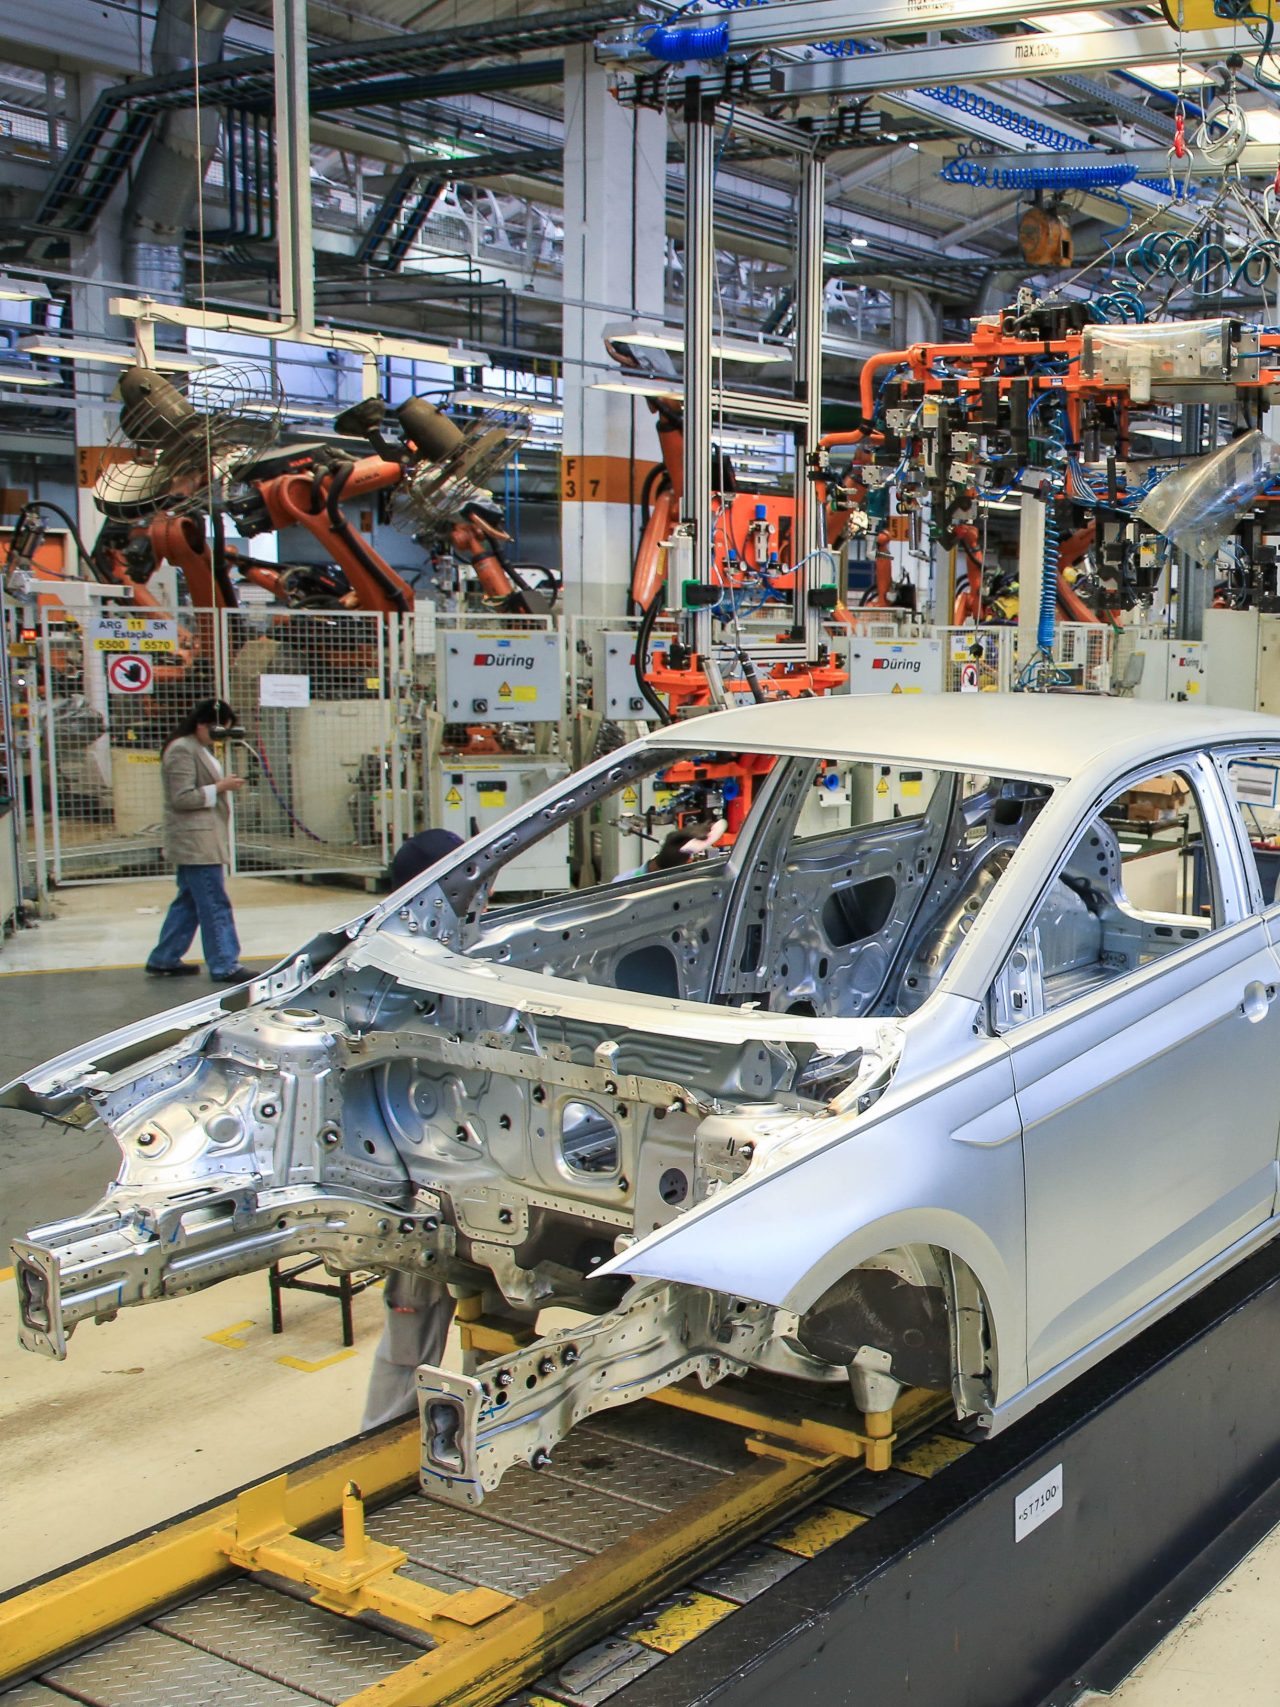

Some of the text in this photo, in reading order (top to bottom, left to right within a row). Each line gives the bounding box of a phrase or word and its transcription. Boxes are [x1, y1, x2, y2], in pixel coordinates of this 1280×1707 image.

[566, 459, 576, 477] F
[99, 621, 122, 629] ARG
[152, 622, 168, 630] SK
[113, 630, 154, 639] Estação
[98, 640, 126, 649] 5500
[144, 640, 171, 650] 5570
[485, 653, 535, 670] Düring
[881, 658, 921, 673] Düring
